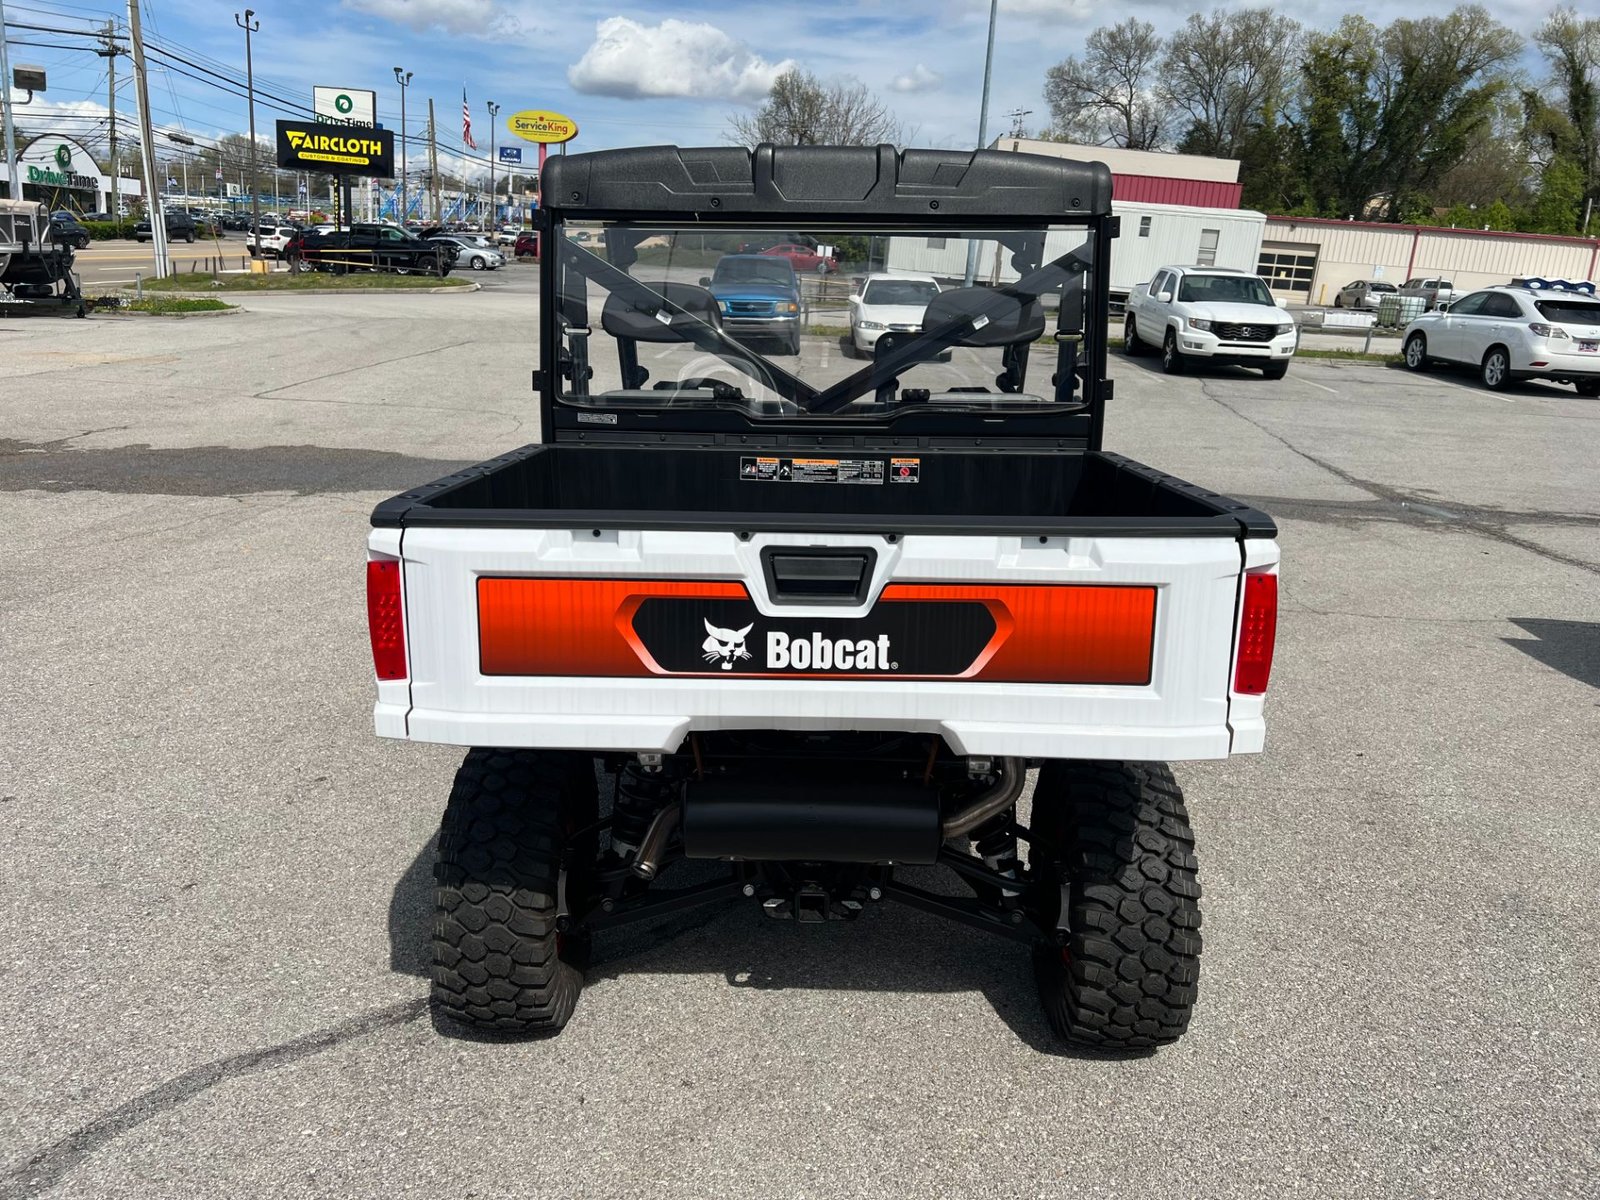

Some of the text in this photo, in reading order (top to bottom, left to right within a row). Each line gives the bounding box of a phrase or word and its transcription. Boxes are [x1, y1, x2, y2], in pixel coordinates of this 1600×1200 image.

[285, 130, 382, 156] FAIRCLOTH
[337, 156, 367, 164] COATINGS
[28, 166, 99, 188] DriveTime
[766, 631, 891, 670] Bobcat
